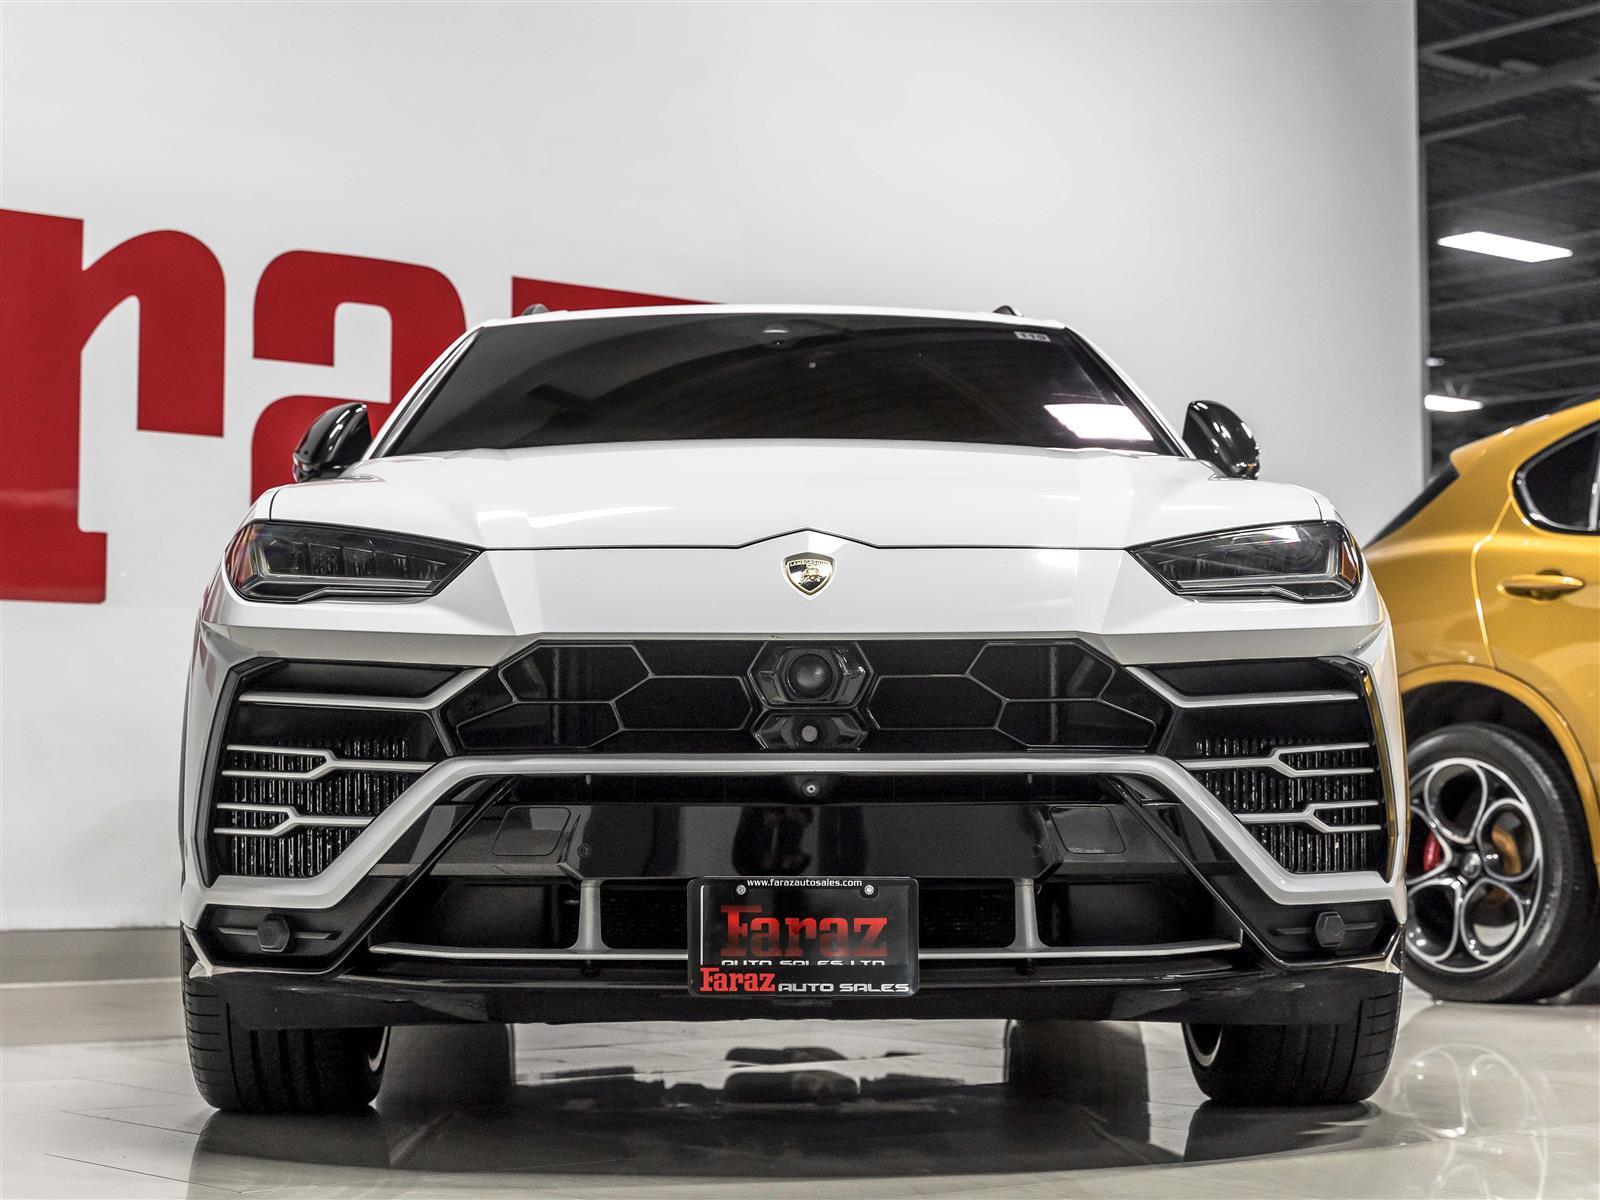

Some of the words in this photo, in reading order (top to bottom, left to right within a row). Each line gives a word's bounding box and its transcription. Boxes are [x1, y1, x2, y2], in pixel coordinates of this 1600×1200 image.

[746, 878, 863, 887] www.farazautosales.com
[721, 904, 888, 957] Faraz
[700, 967, 776, 992] Faraz
[777, 983, 834, 992] AUTO
[839, 983, 910, 992] SALES
